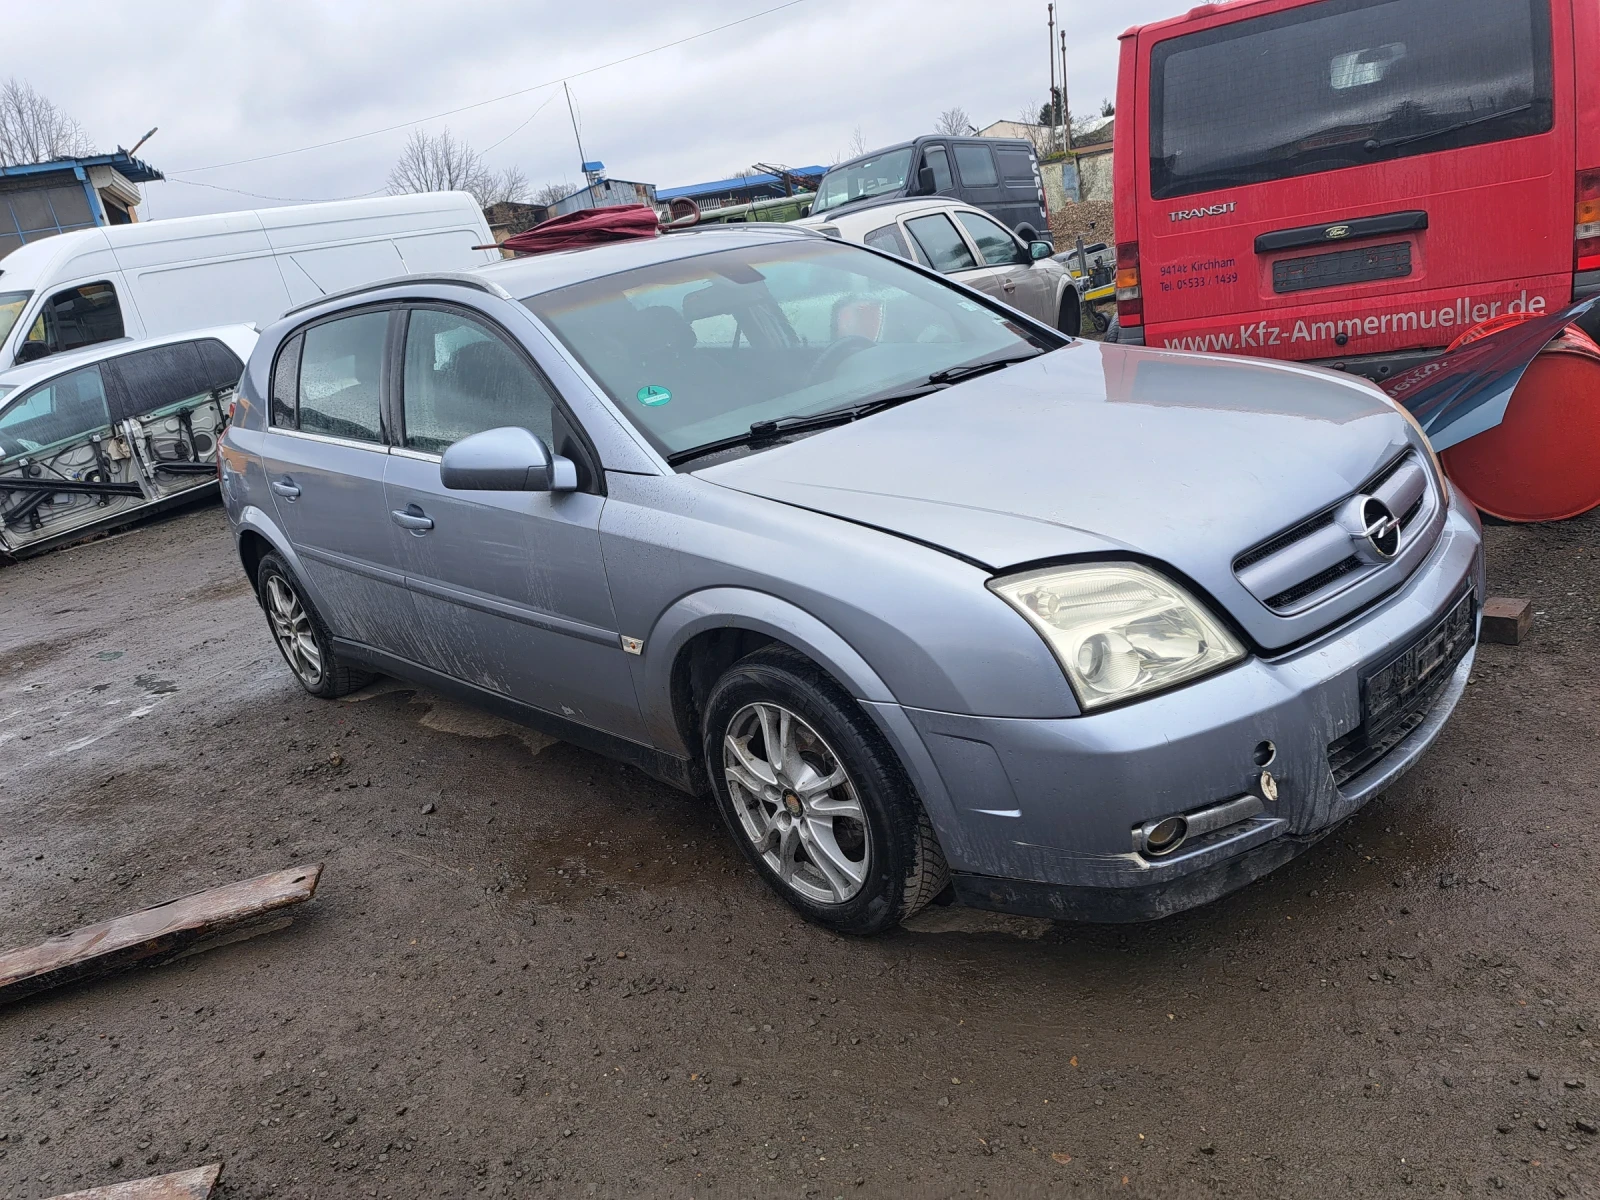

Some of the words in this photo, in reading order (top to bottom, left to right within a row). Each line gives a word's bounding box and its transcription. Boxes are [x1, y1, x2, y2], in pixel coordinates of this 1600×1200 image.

[1168, 201, 1237, 221] TRANSIT
[1191, 258, 1235, 272] Kirchham
[1160, 281, 1175, 292] Tel.
[1163, 289, 1546, 352] www.Kfz-Ammermuellerde
